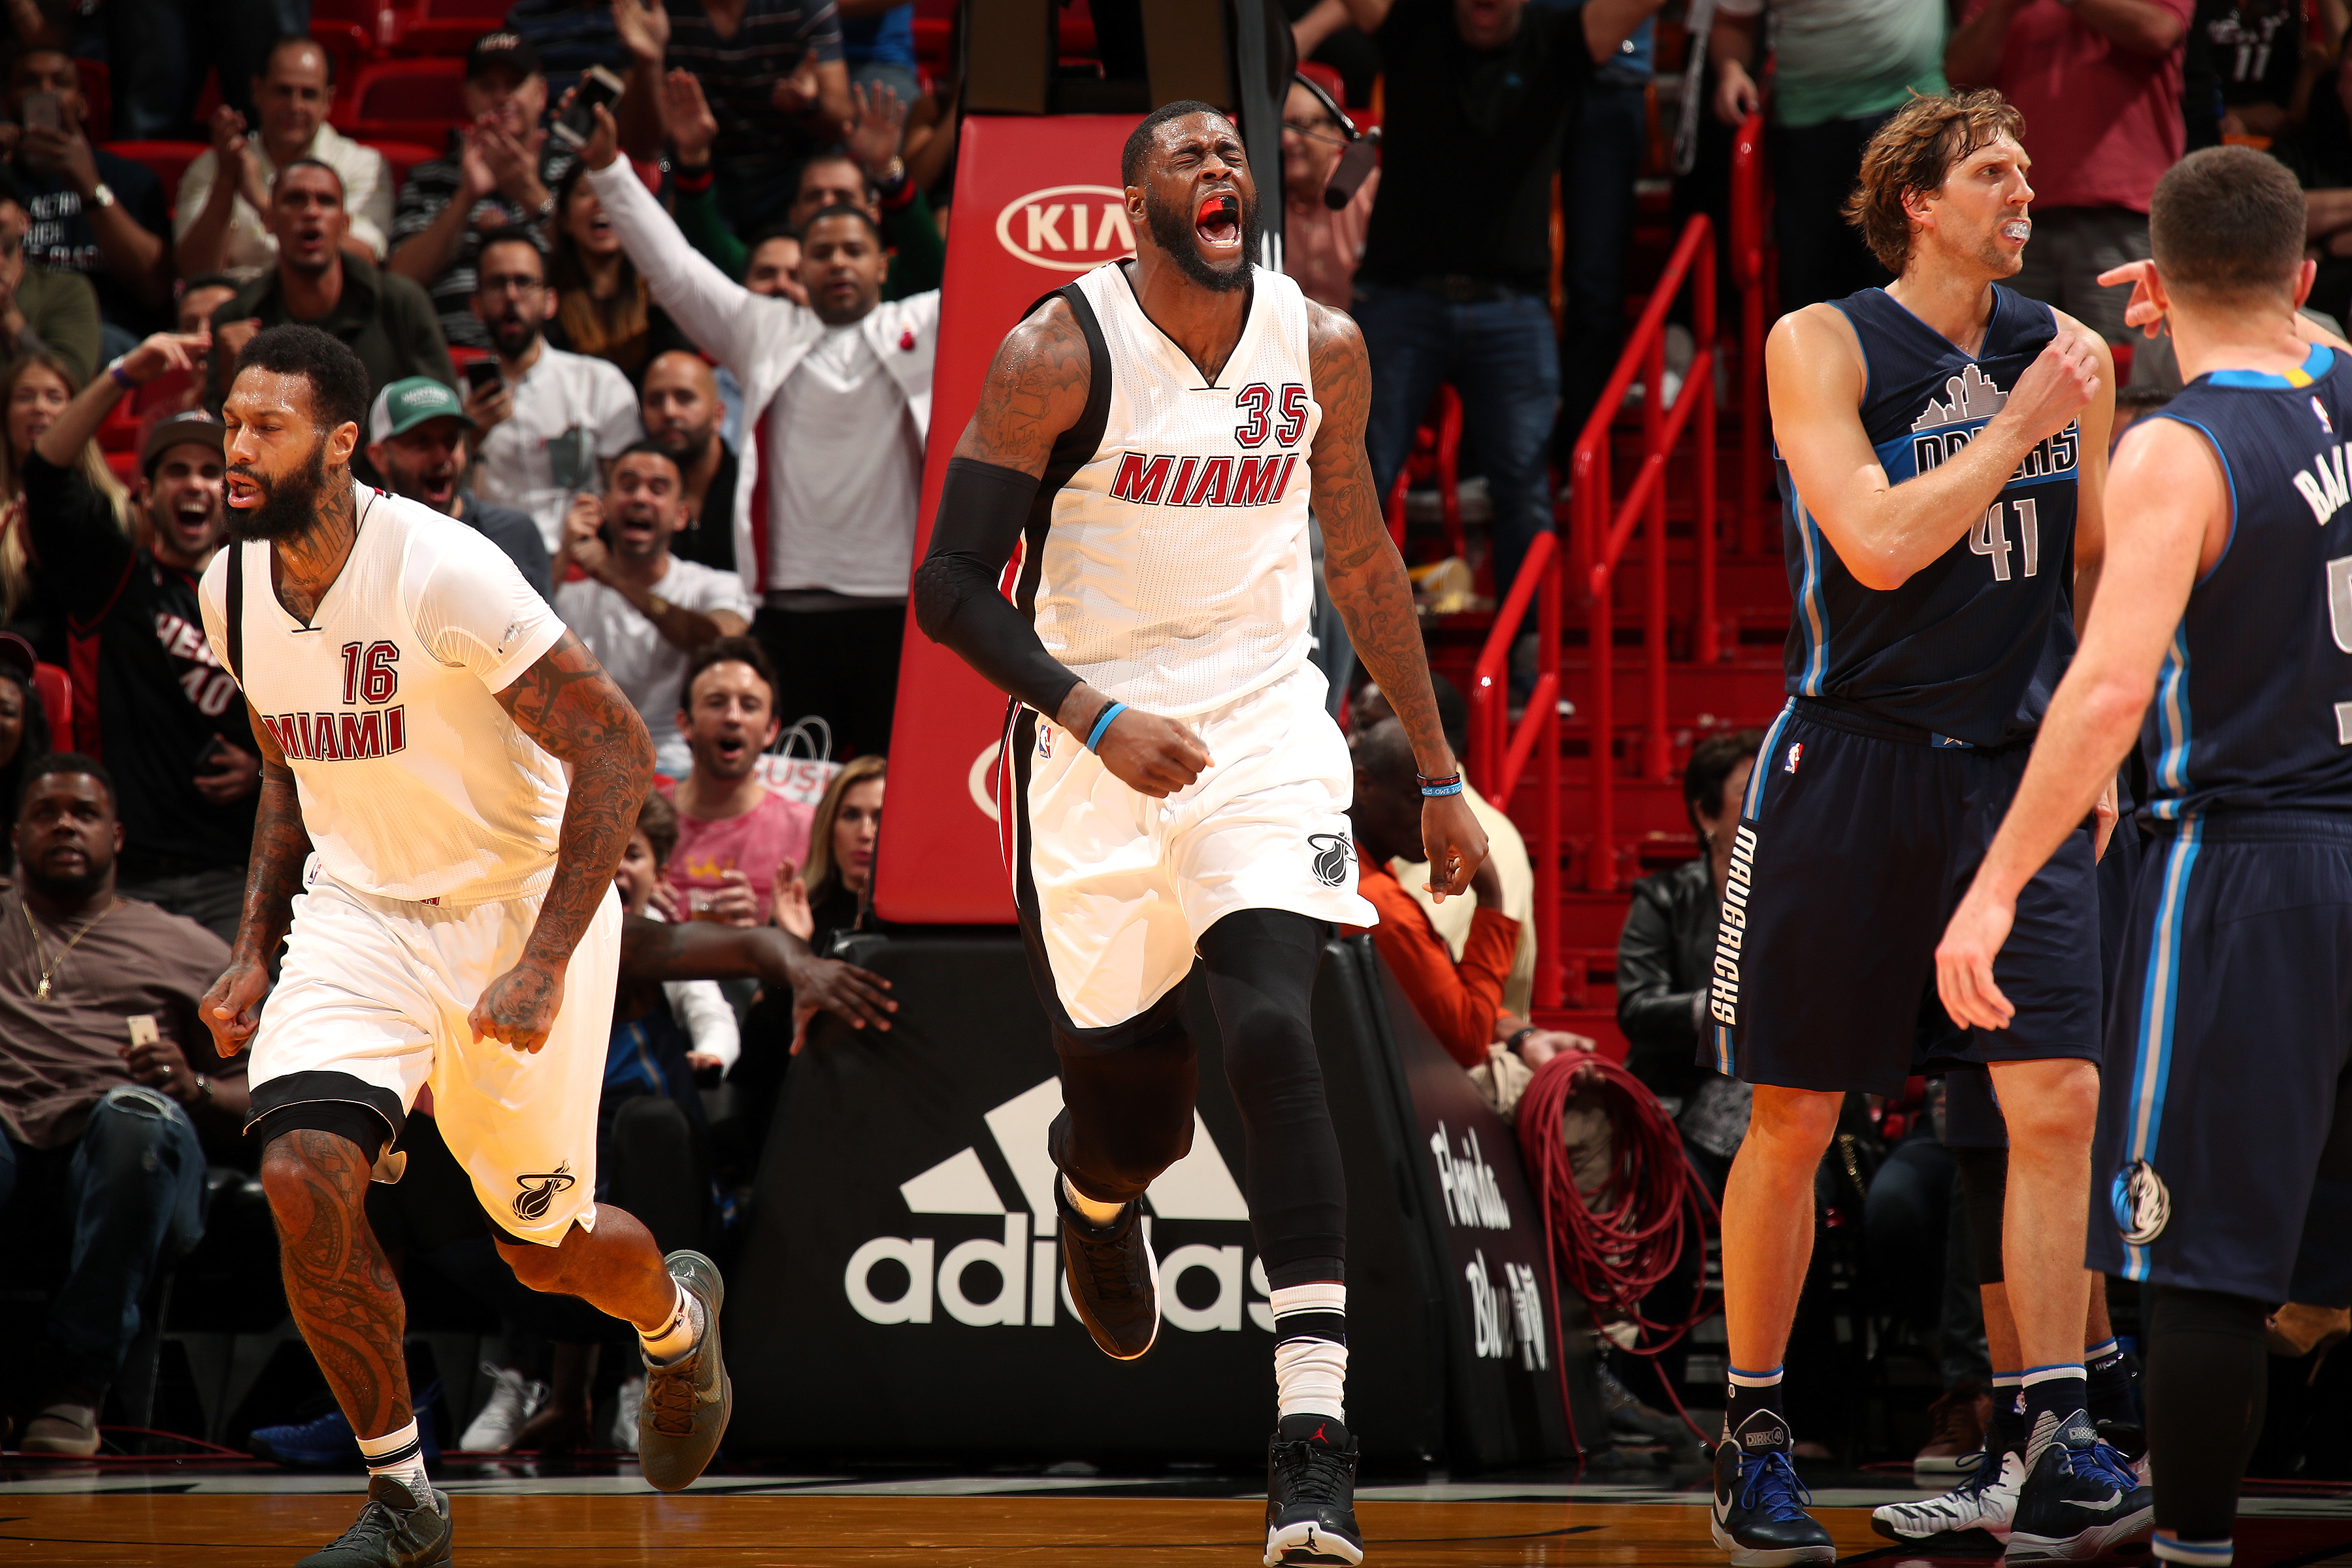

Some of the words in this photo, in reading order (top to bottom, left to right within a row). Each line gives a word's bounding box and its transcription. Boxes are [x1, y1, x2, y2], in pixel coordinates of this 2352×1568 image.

[2232, 43, 2271, 82] 11
[1026, 203, 1137, 252] KIA
[1234, 382, 1309, 449] 35
[1109, 451, 1299, 507] MIAMI
[1914, 417, 2079, 482] DAAS
[2293, 442, 2352, 527] BAR
[1969, 498, 2038, 581] 41
[342, 640, 400, 705] 16
[262, 704, 406, 762] MIAMI
[1711, 825, 1757, 1025] MAVERICKS
[1430, 1119, 1511, 1230] Florida
[845, 1212, 1277, 1334] adia
[1465, 1247, 1514, 1360] Blue
[1746, 1432, 1774, 1446] DIRK
